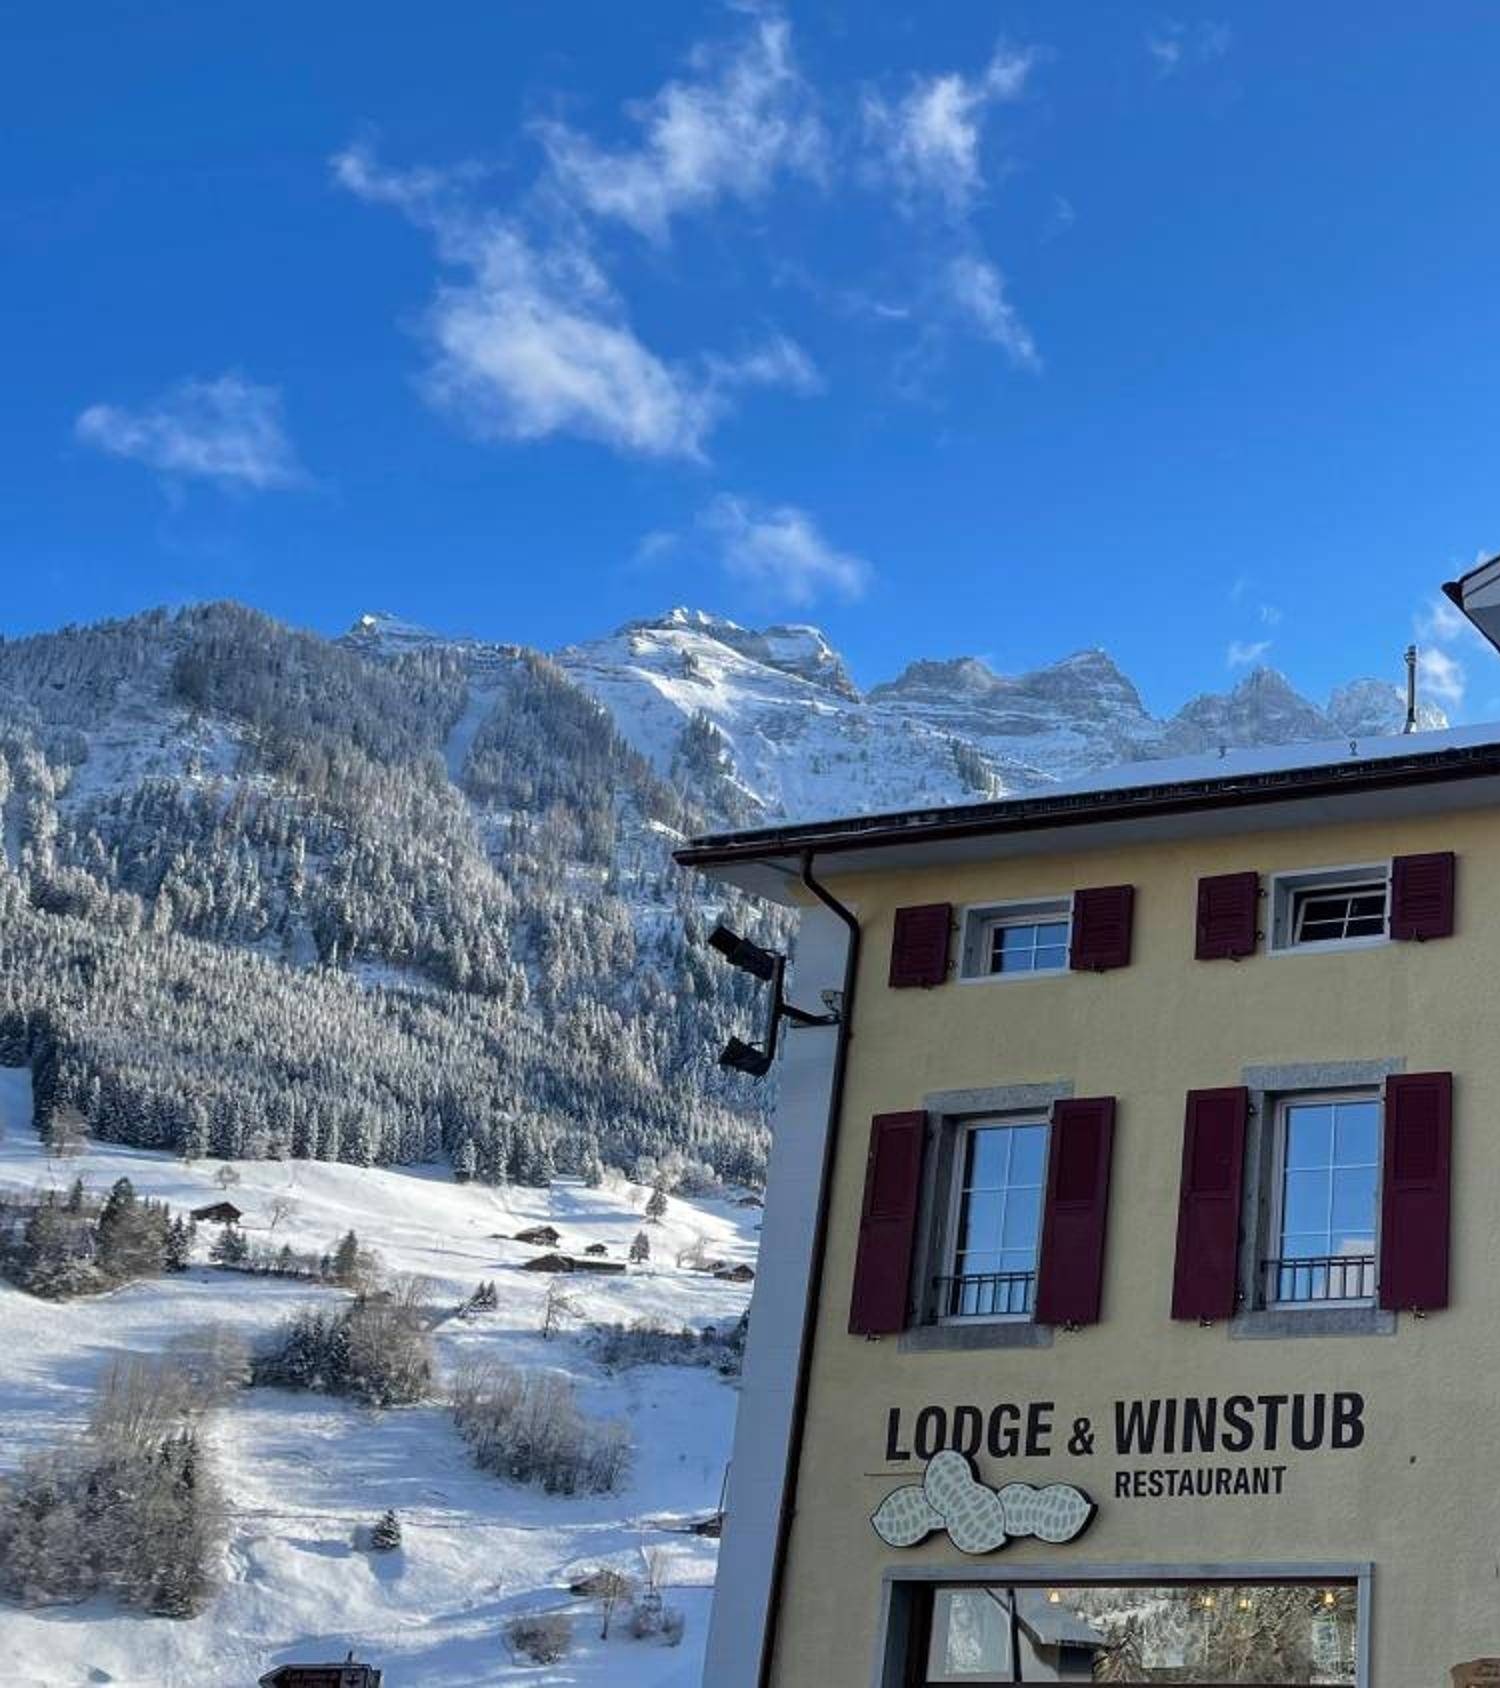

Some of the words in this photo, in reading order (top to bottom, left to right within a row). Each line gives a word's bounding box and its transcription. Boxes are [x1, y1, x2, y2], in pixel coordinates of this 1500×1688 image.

[885, 1402, 1055, 1461] LODGE
[1067, 1417, 1095, 1456] &
[1113, 1392, 1366, 1455] WINSTUB
[1114, 1466, 1288, 1498] RESTAURANT
